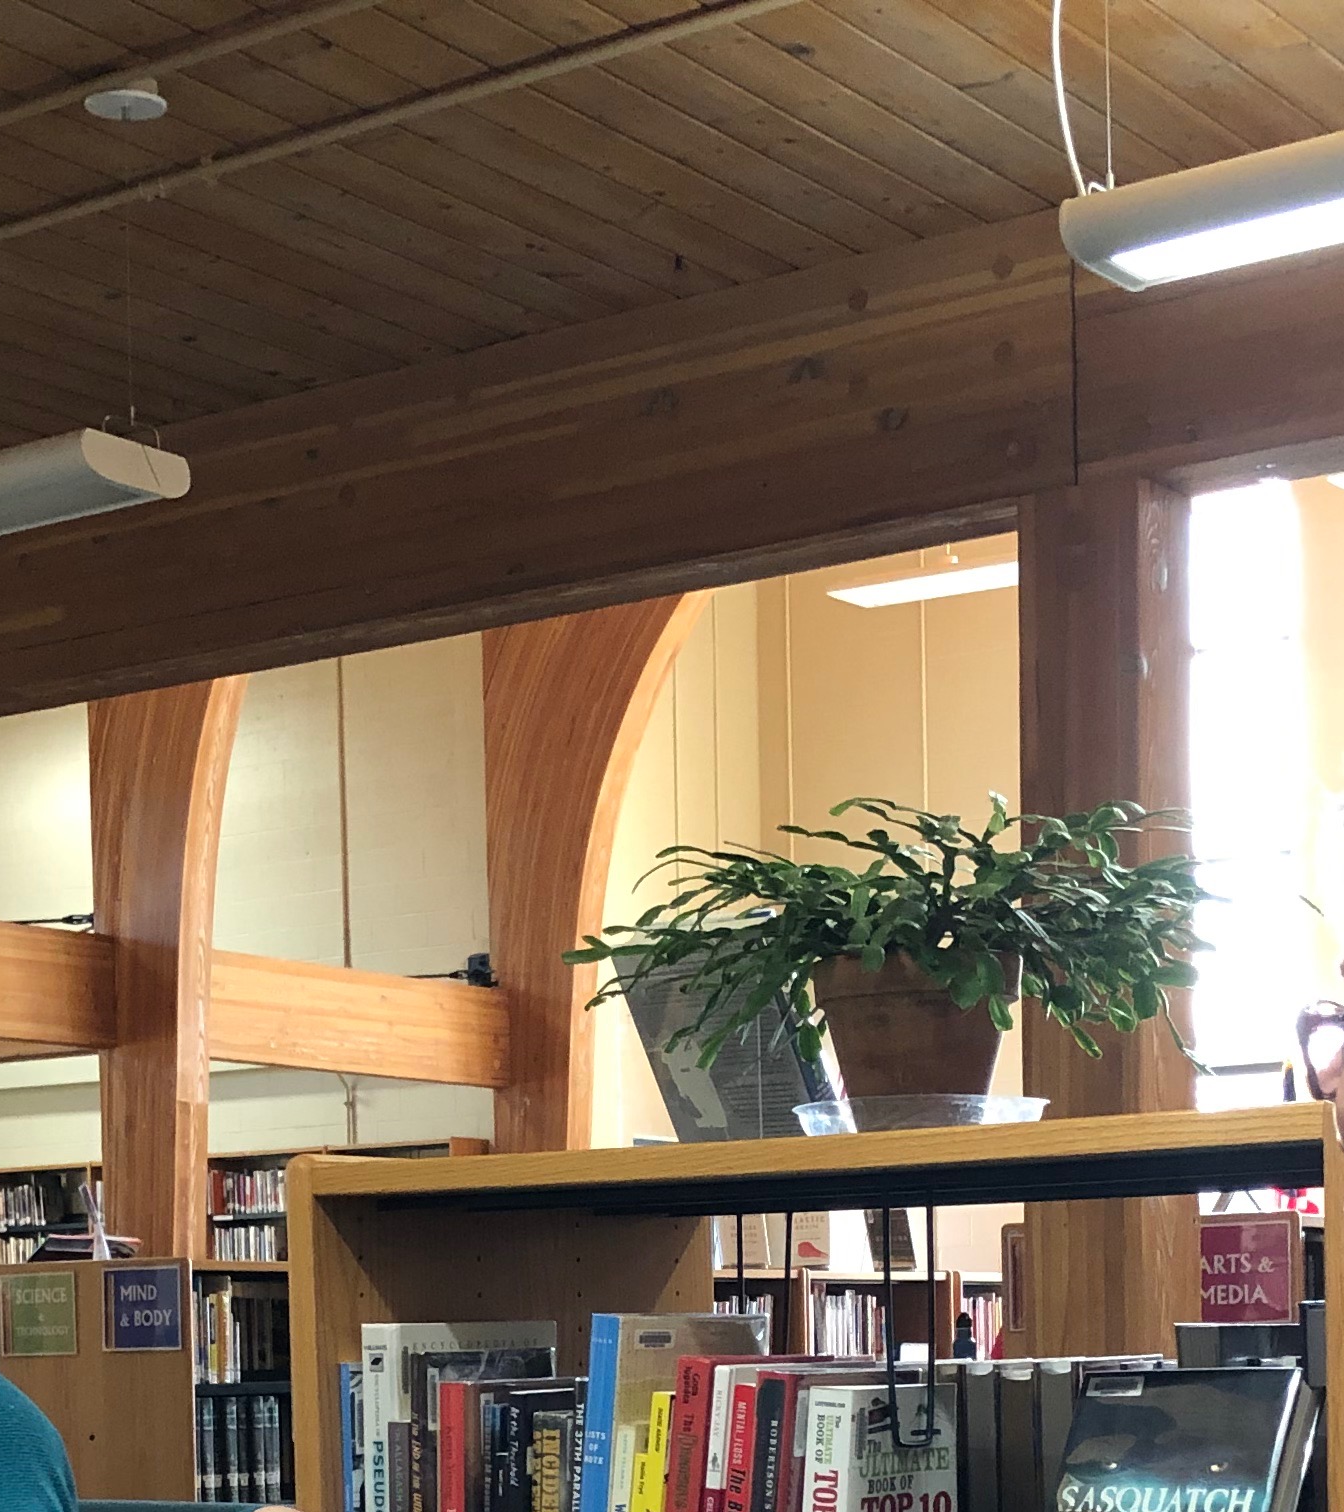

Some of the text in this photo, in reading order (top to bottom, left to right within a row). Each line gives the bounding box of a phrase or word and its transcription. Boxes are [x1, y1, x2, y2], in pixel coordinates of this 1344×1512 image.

[1201, 1253, 1275, 1275] ARTS &
[16, 1287, 67, 1304] SCIENCE
[120, 1285, 157, 1301] MIND
[1201, 1284, 1268, 1305] MEDIA
[120, 1309, 172, 1327] & BODY
[574, 1403, 585, 1426] THE
[573, 1430, 584, 1462] 37TH
[814, 1414, 824, 1464] BOOK OF
[824, 1414, 834, 1464] ULTIMATE
[509, 1440, 519, 1486] Threshold
[728, 1467, 746, 1495] The
[868, 1475, 914, 1494] BOOK OF
